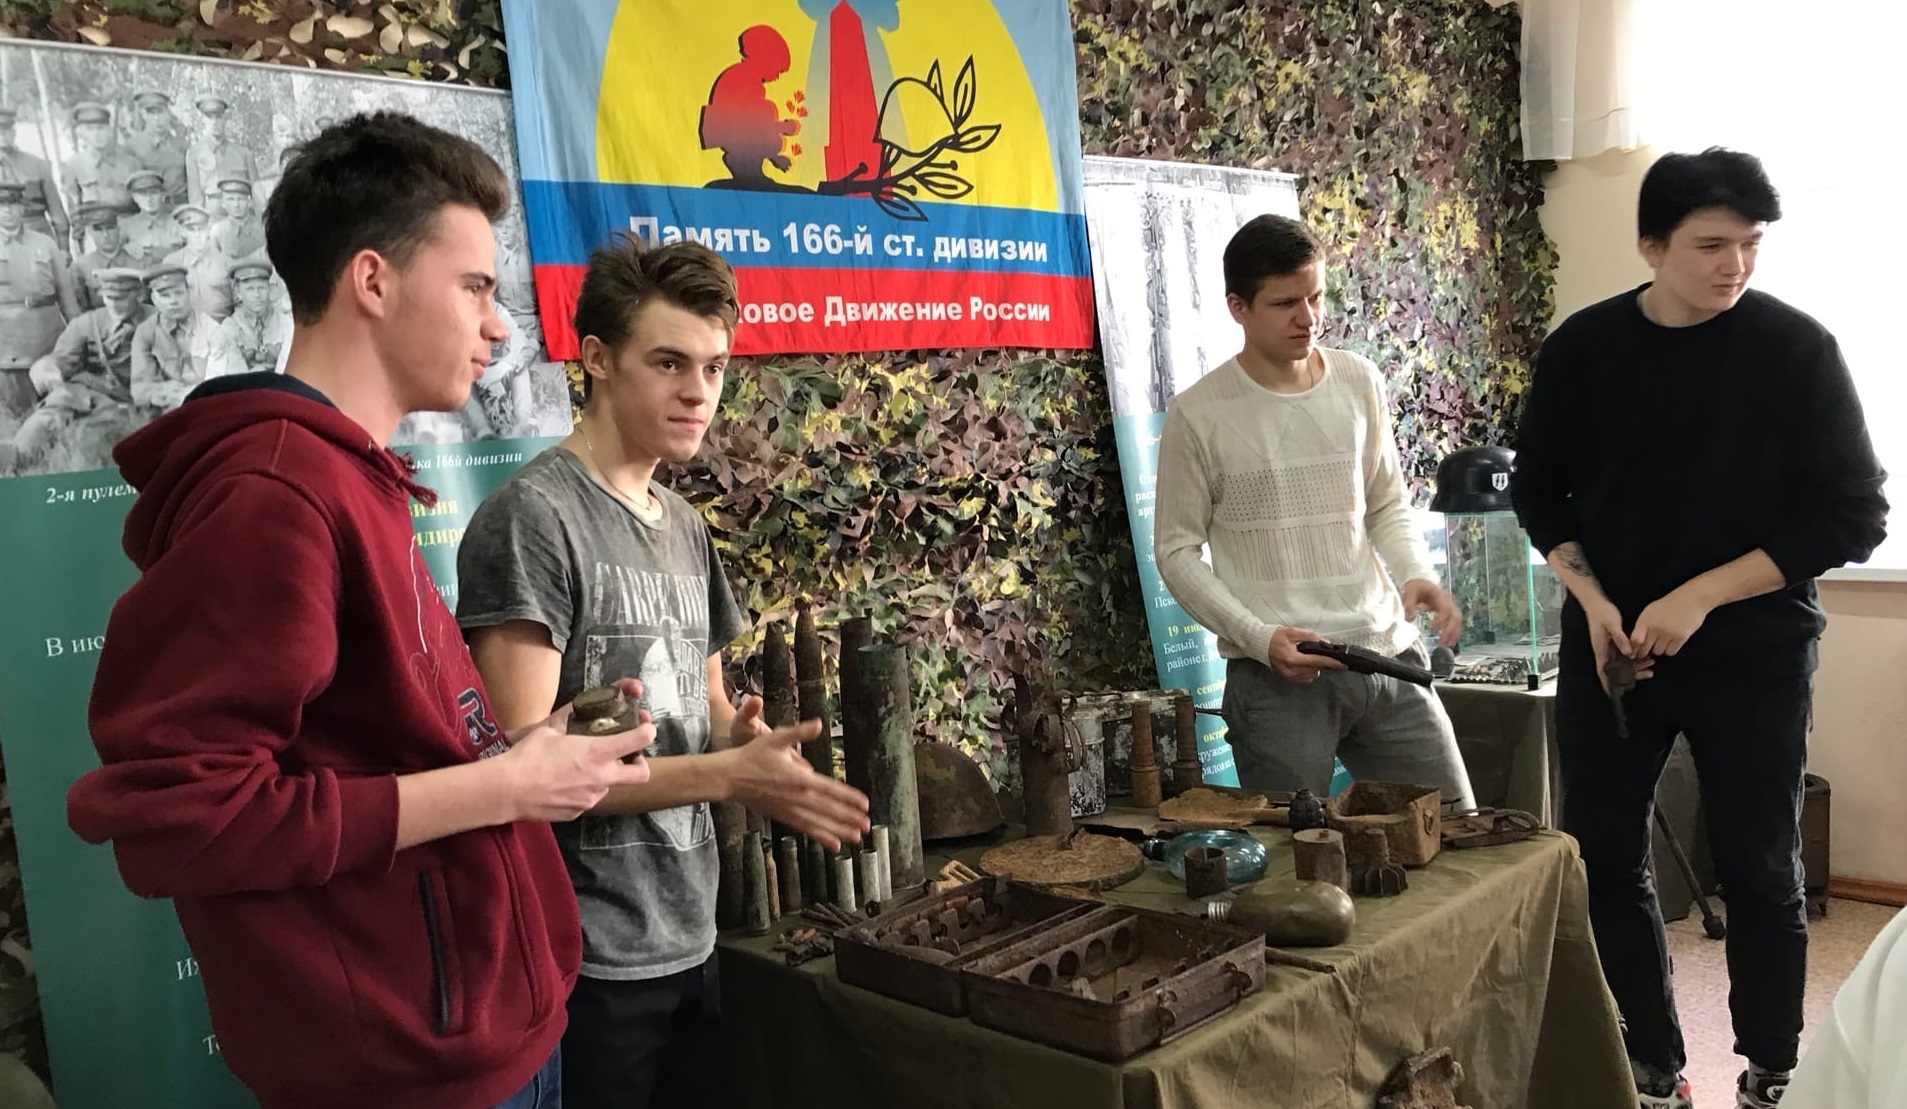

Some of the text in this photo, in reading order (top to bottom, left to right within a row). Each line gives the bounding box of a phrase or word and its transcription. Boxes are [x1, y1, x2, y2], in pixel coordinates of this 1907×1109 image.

[630, 217, 1048, 263] Память 166-й ст. дивизии
[738, 296, 1050, 327] овое Движение России
[411, 458, 431, 469] ка
[465, 452, 523, 466] дивизии
[46, 487, 75, 503] 2-я
[410, 499, 458, 518] изия
[1167, 625, 1179, 637] 19
[45, 637, 64, 658] В
